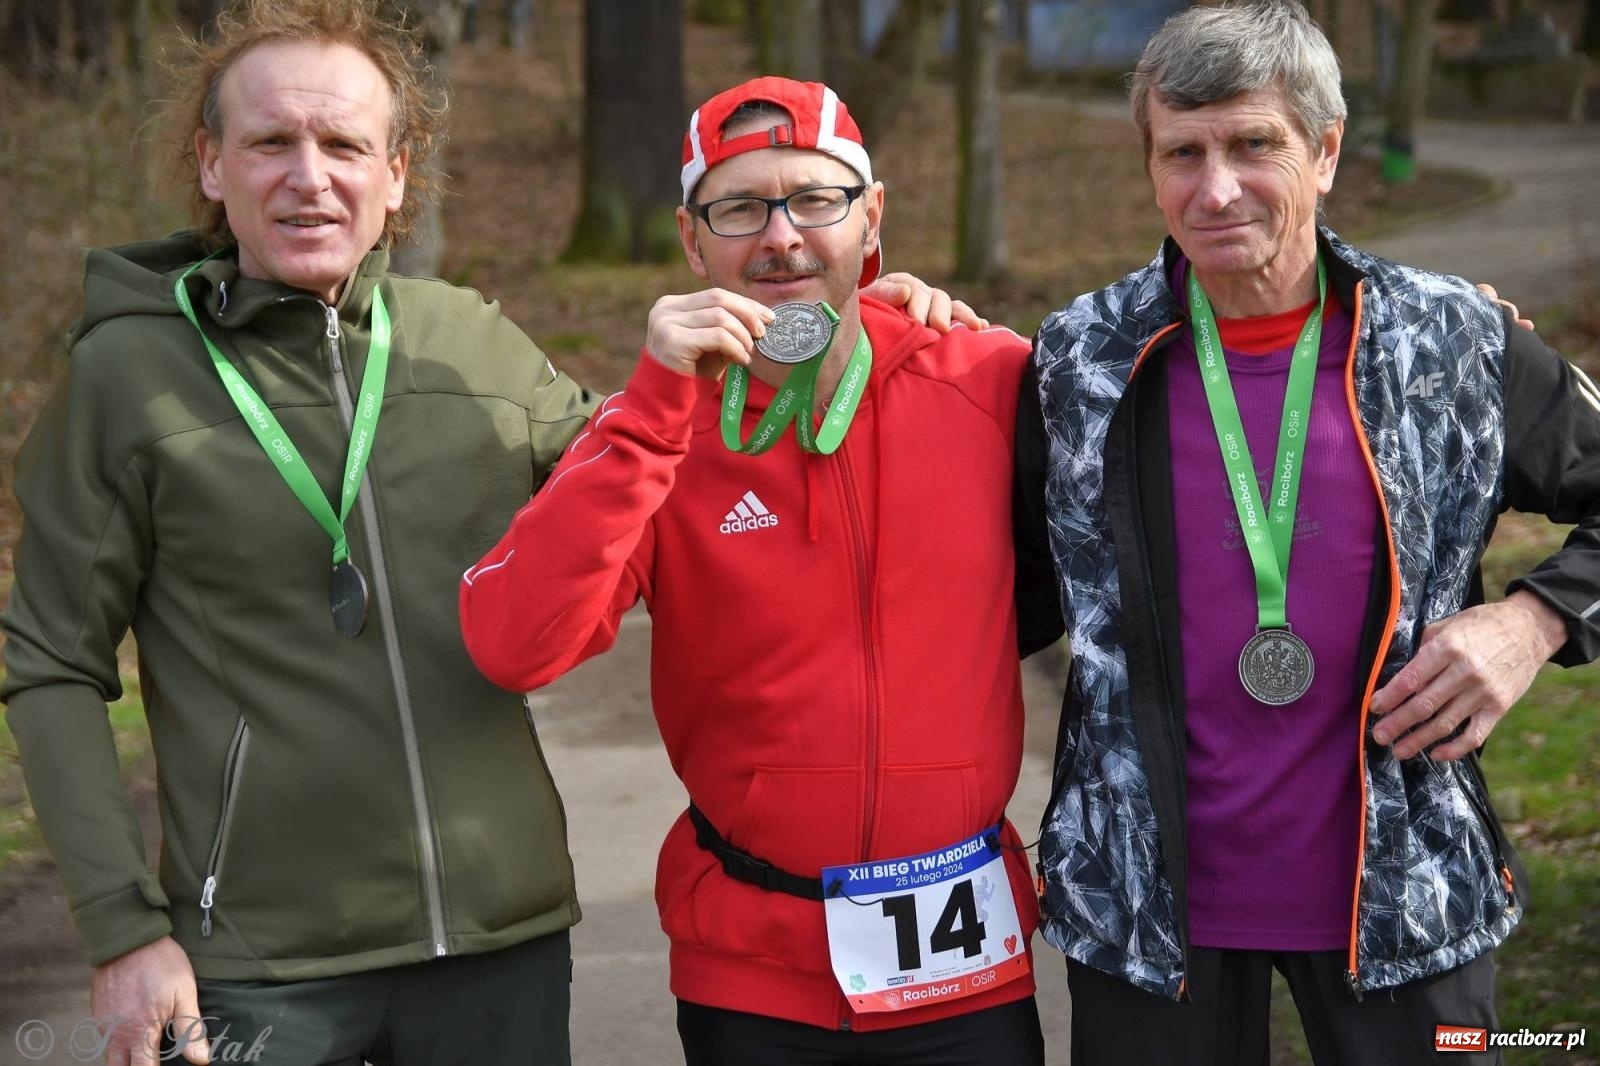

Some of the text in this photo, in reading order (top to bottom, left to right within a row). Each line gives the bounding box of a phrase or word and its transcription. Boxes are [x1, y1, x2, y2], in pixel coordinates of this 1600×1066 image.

[1200, 317, 1216, 368] Racibórz
[775, 388, 797, 415] OSiR
[838, 363, 863, 413] Racibórz
[234, 382, 293, 465] Racibórz OSiR
[349, 392, 376, 481] Racibórz OSiR
[1225, 432, 1259, 527] Racibórz OSiR
[1277, 409, 1301, 507] Racibórz OSiR
[719, 514, 779, 534] adidas
[848, 836, 987, 881] XII BIEG TWARDZIELA
[895, 862, 963, 887] 25 lutego 2024
[881, 878, 987, 972] 14
[902, 983, 961, 1003] Racibórz
[971, 969, 997, 988] OSiR
